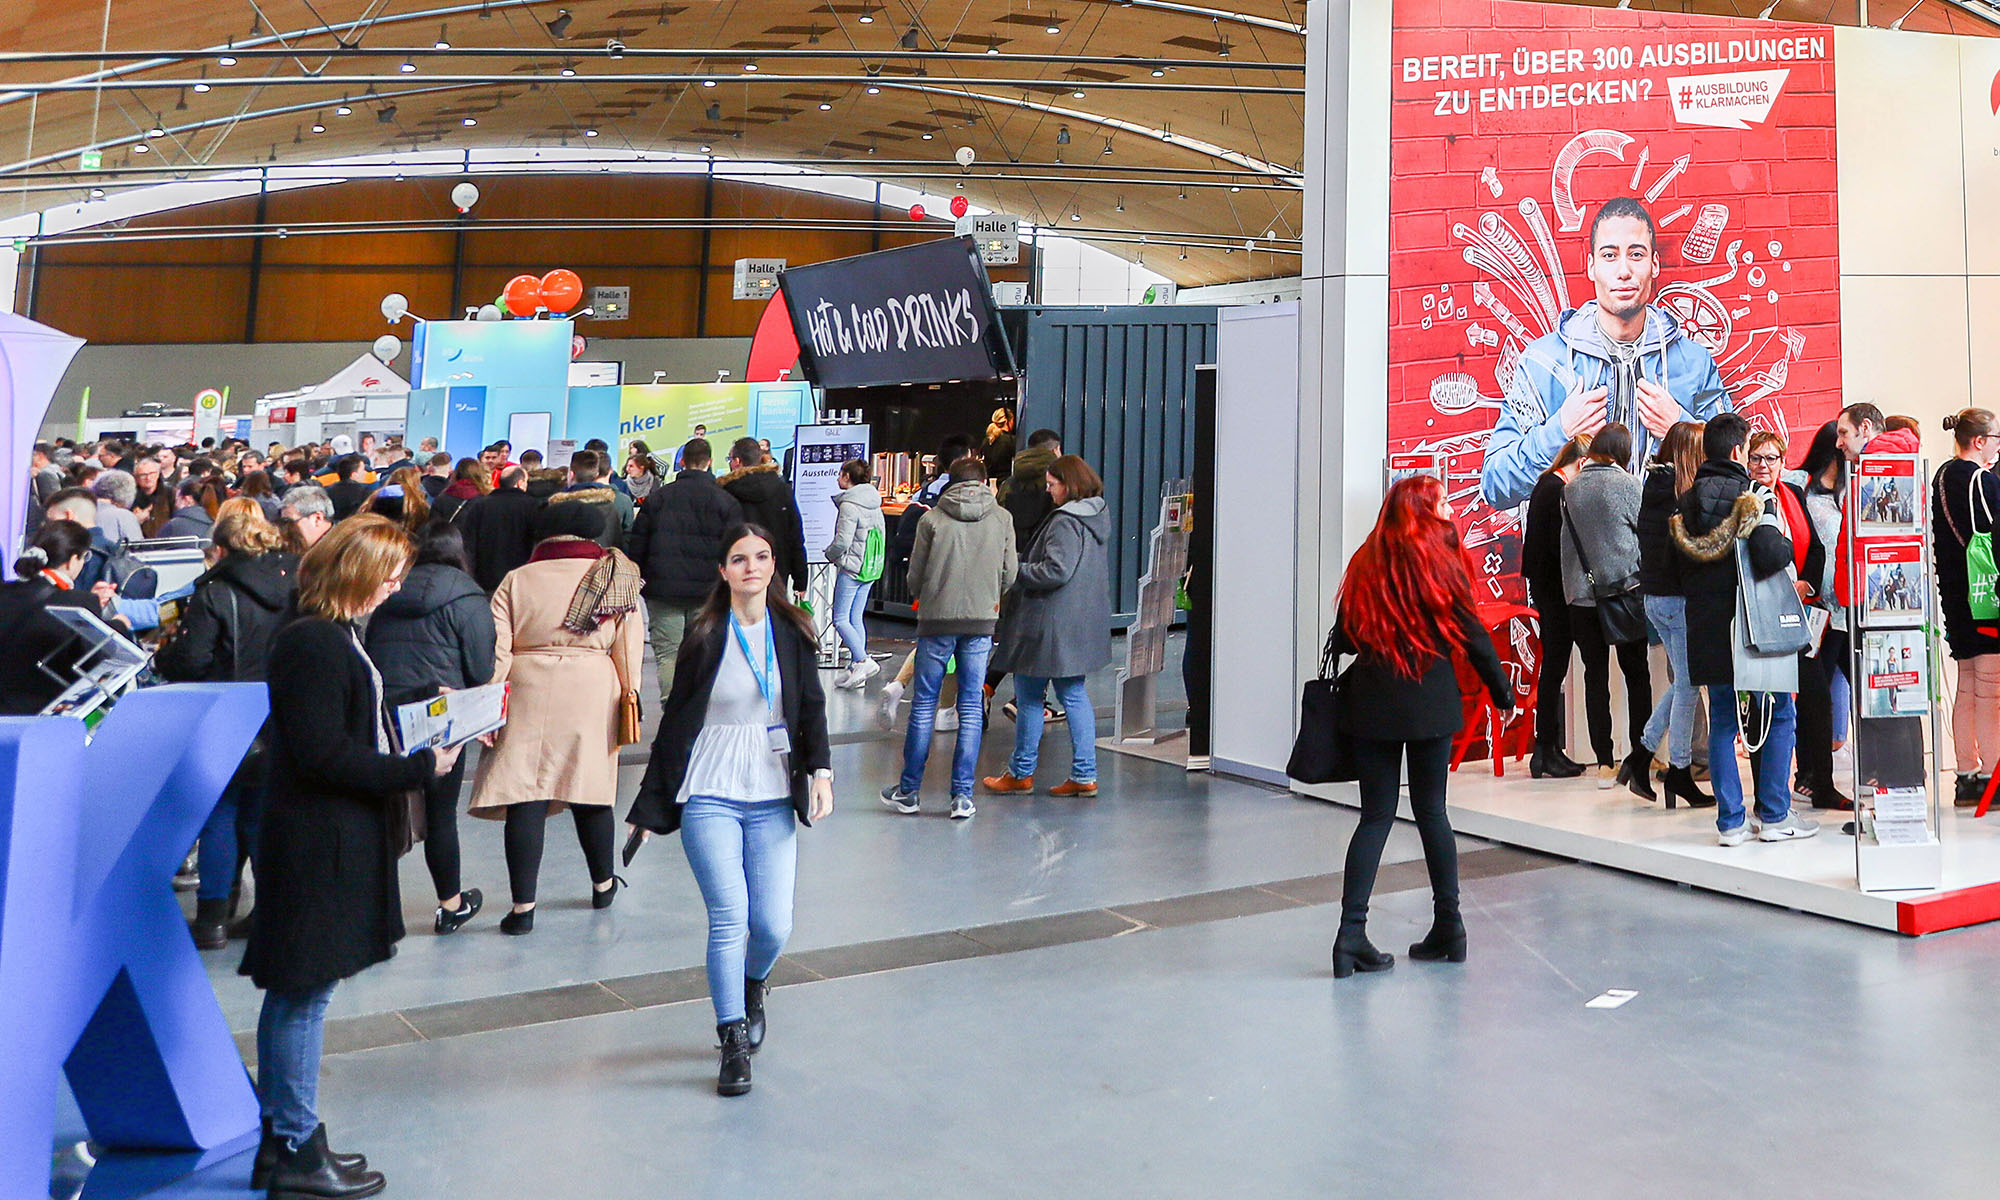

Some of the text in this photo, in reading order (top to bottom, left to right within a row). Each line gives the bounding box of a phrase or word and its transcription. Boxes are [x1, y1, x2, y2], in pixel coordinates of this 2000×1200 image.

[1402, 36, 1826, 84] BEREIT, ÜBER 300 AUSBILDUNGEN
[1695, 80, 1769, 96] AUSBILDUNG
[1433, 79, 1653, 117] ZU ENTDECKEN?
[1696, 94, 1770, 109] KLARMACHEN
[975, 220, 1017, 233] Halle 1
[748, 263, 775, 273] Halle
[597, 290, 628, 299] Halle 1
[833, 308, 853, 354] &
[886, 287, 979, 352] DRINKS
